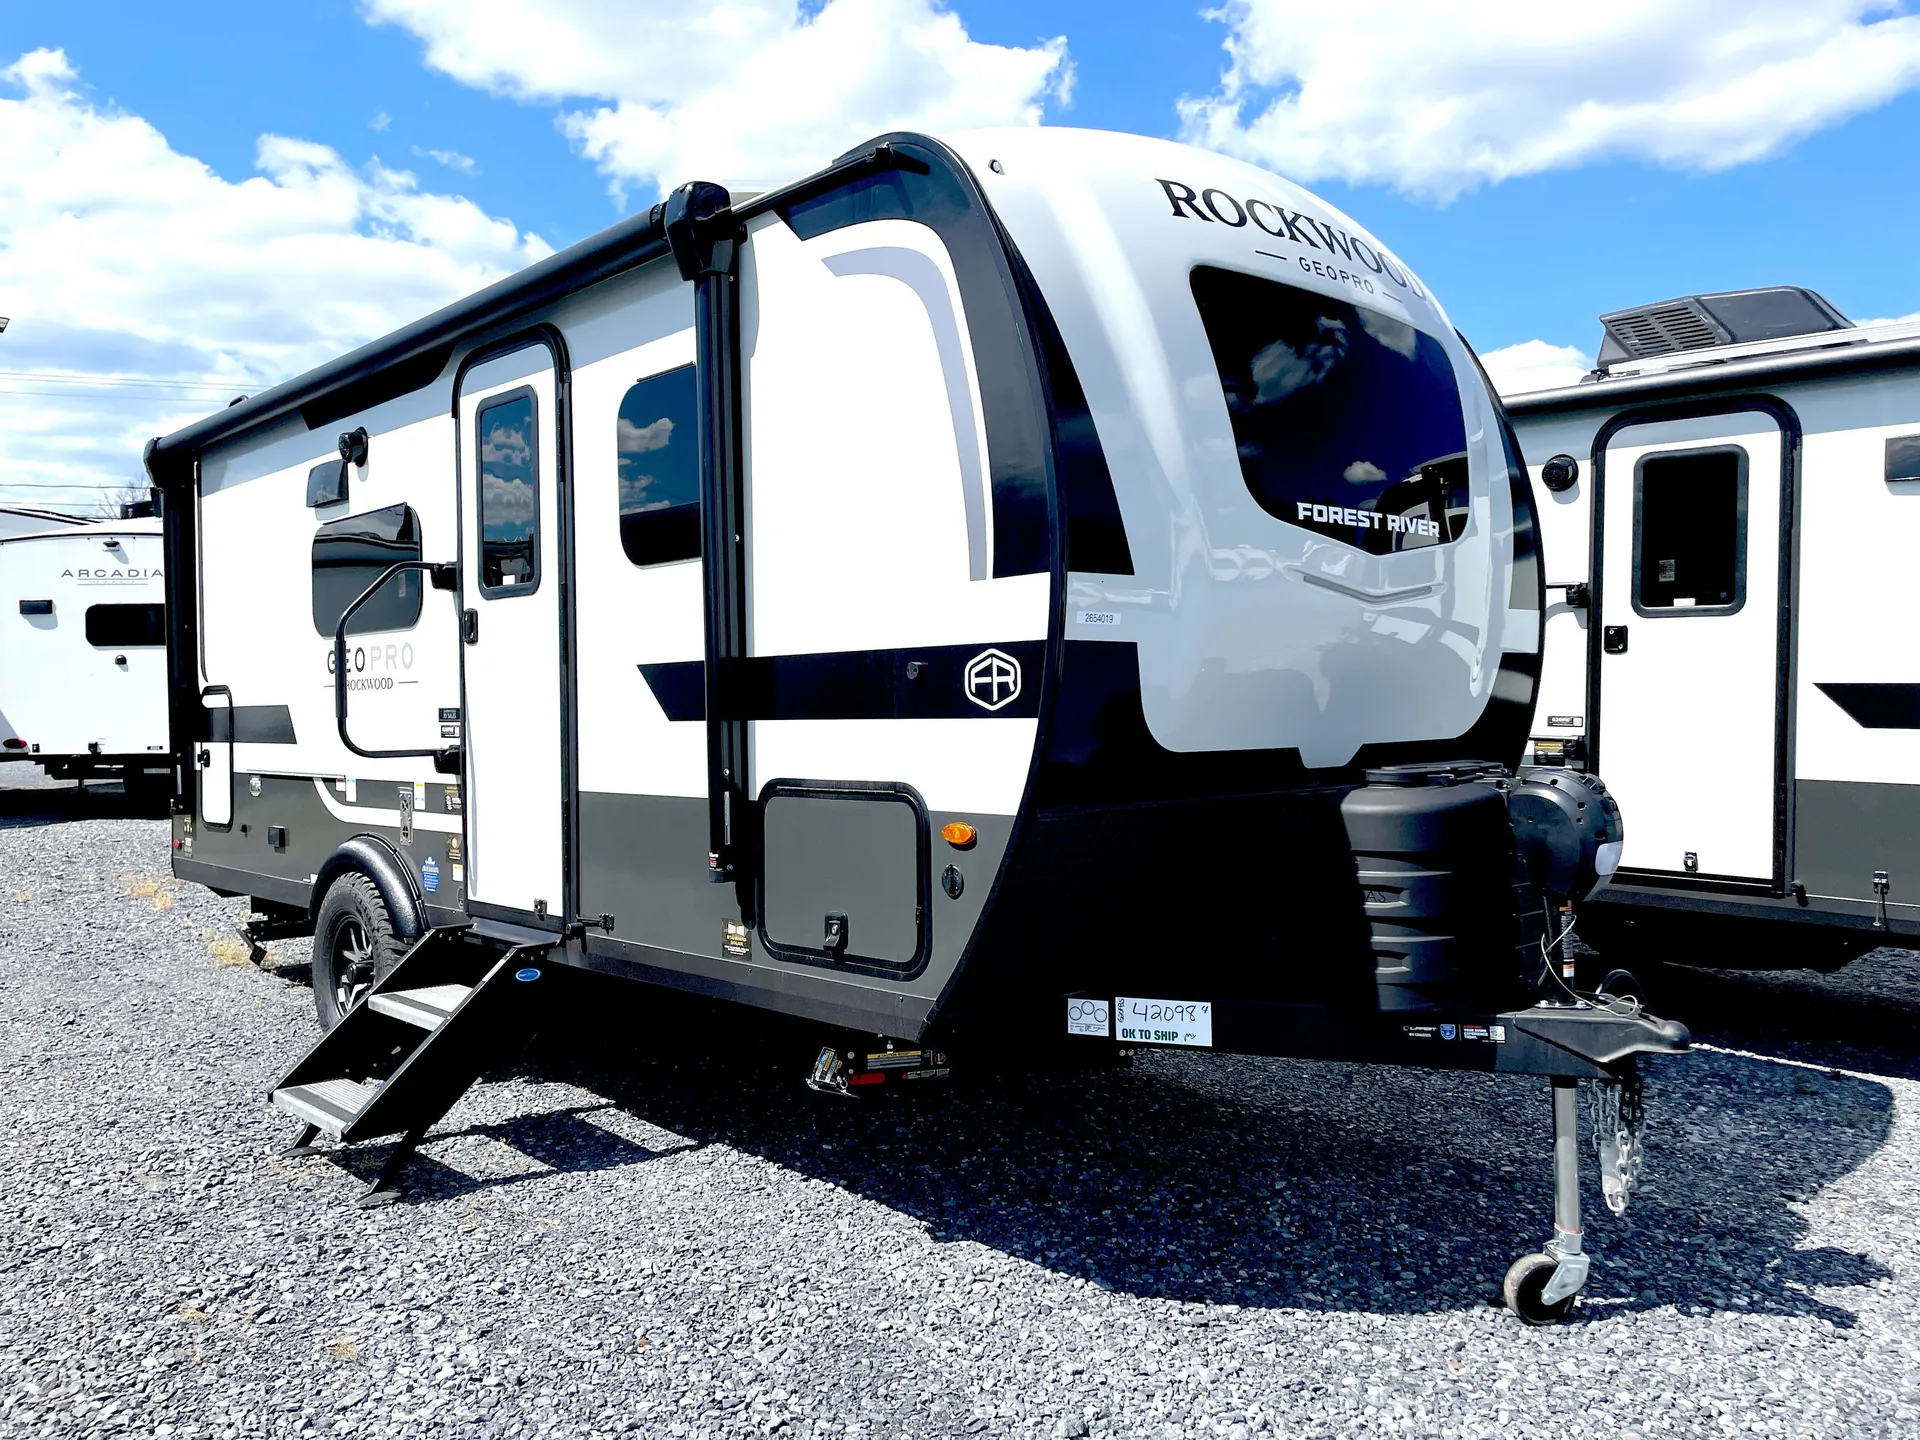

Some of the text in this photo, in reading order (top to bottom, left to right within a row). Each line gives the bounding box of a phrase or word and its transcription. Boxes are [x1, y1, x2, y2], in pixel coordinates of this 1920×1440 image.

[1154, 178, 1427, 301] ROCKWOOD
[1298, 256, 1375, 295] GEOPRO
[1296, 501, 1440, 538] FOREST RIVER
[61, 569, 164, 578] ARCADIA
[1085, 612, 1114, 624] 2654019
[1132, 1001, 1197, 1022] 42098
[1121, 1027, 1180, 1042] OK TO SHIP
